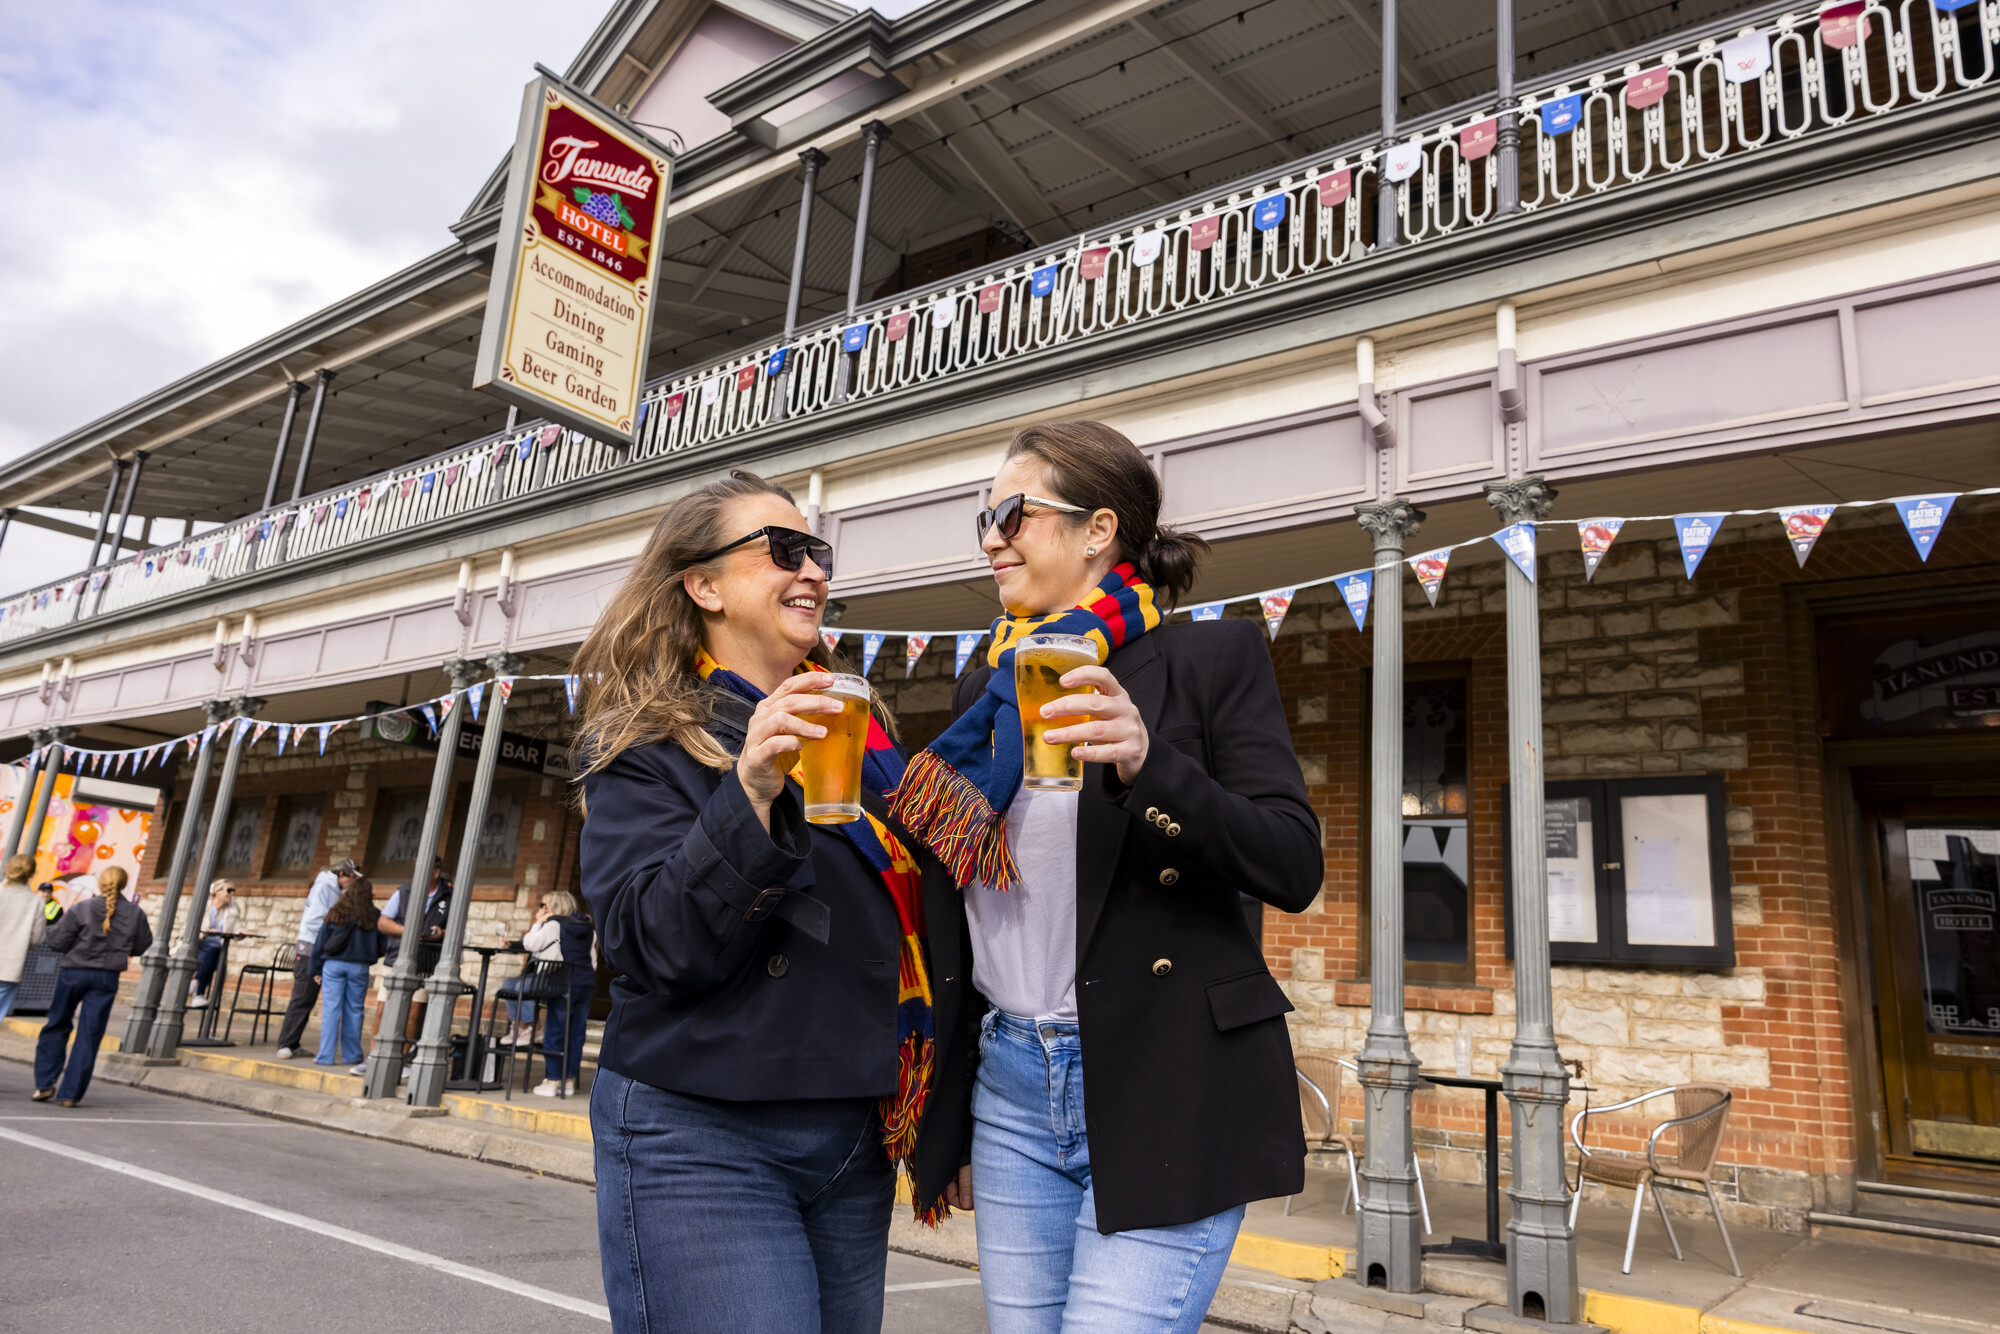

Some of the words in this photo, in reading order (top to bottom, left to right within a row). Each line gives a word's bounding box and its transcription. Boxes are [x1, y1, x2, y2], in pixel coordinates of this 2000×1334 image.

[542, 135, 653, 193] Tanunda
[560, 204, 624, 252] HOTEL
[557, 229, 583, 252] EST
[591, 247, 623, 272] 1846
[530, 253, 635, 321] Accommodation
[553, 298, 606, 344] Dining
[545, 330, 604, 376] Gaming
[521, 352, 558, 386] Beer
[565, 374, 617, 412] Garden
[1907, 507, 1942, 520] GATHER
[1881, 650, 2000, 692] TANUND
[425, 724, 483, 751] TAER
[502, 738, 539, 760] BAR
[1931, 892, 1990, 905] TANUNDA
[1939, 916, 1988, 928] HOTEL
